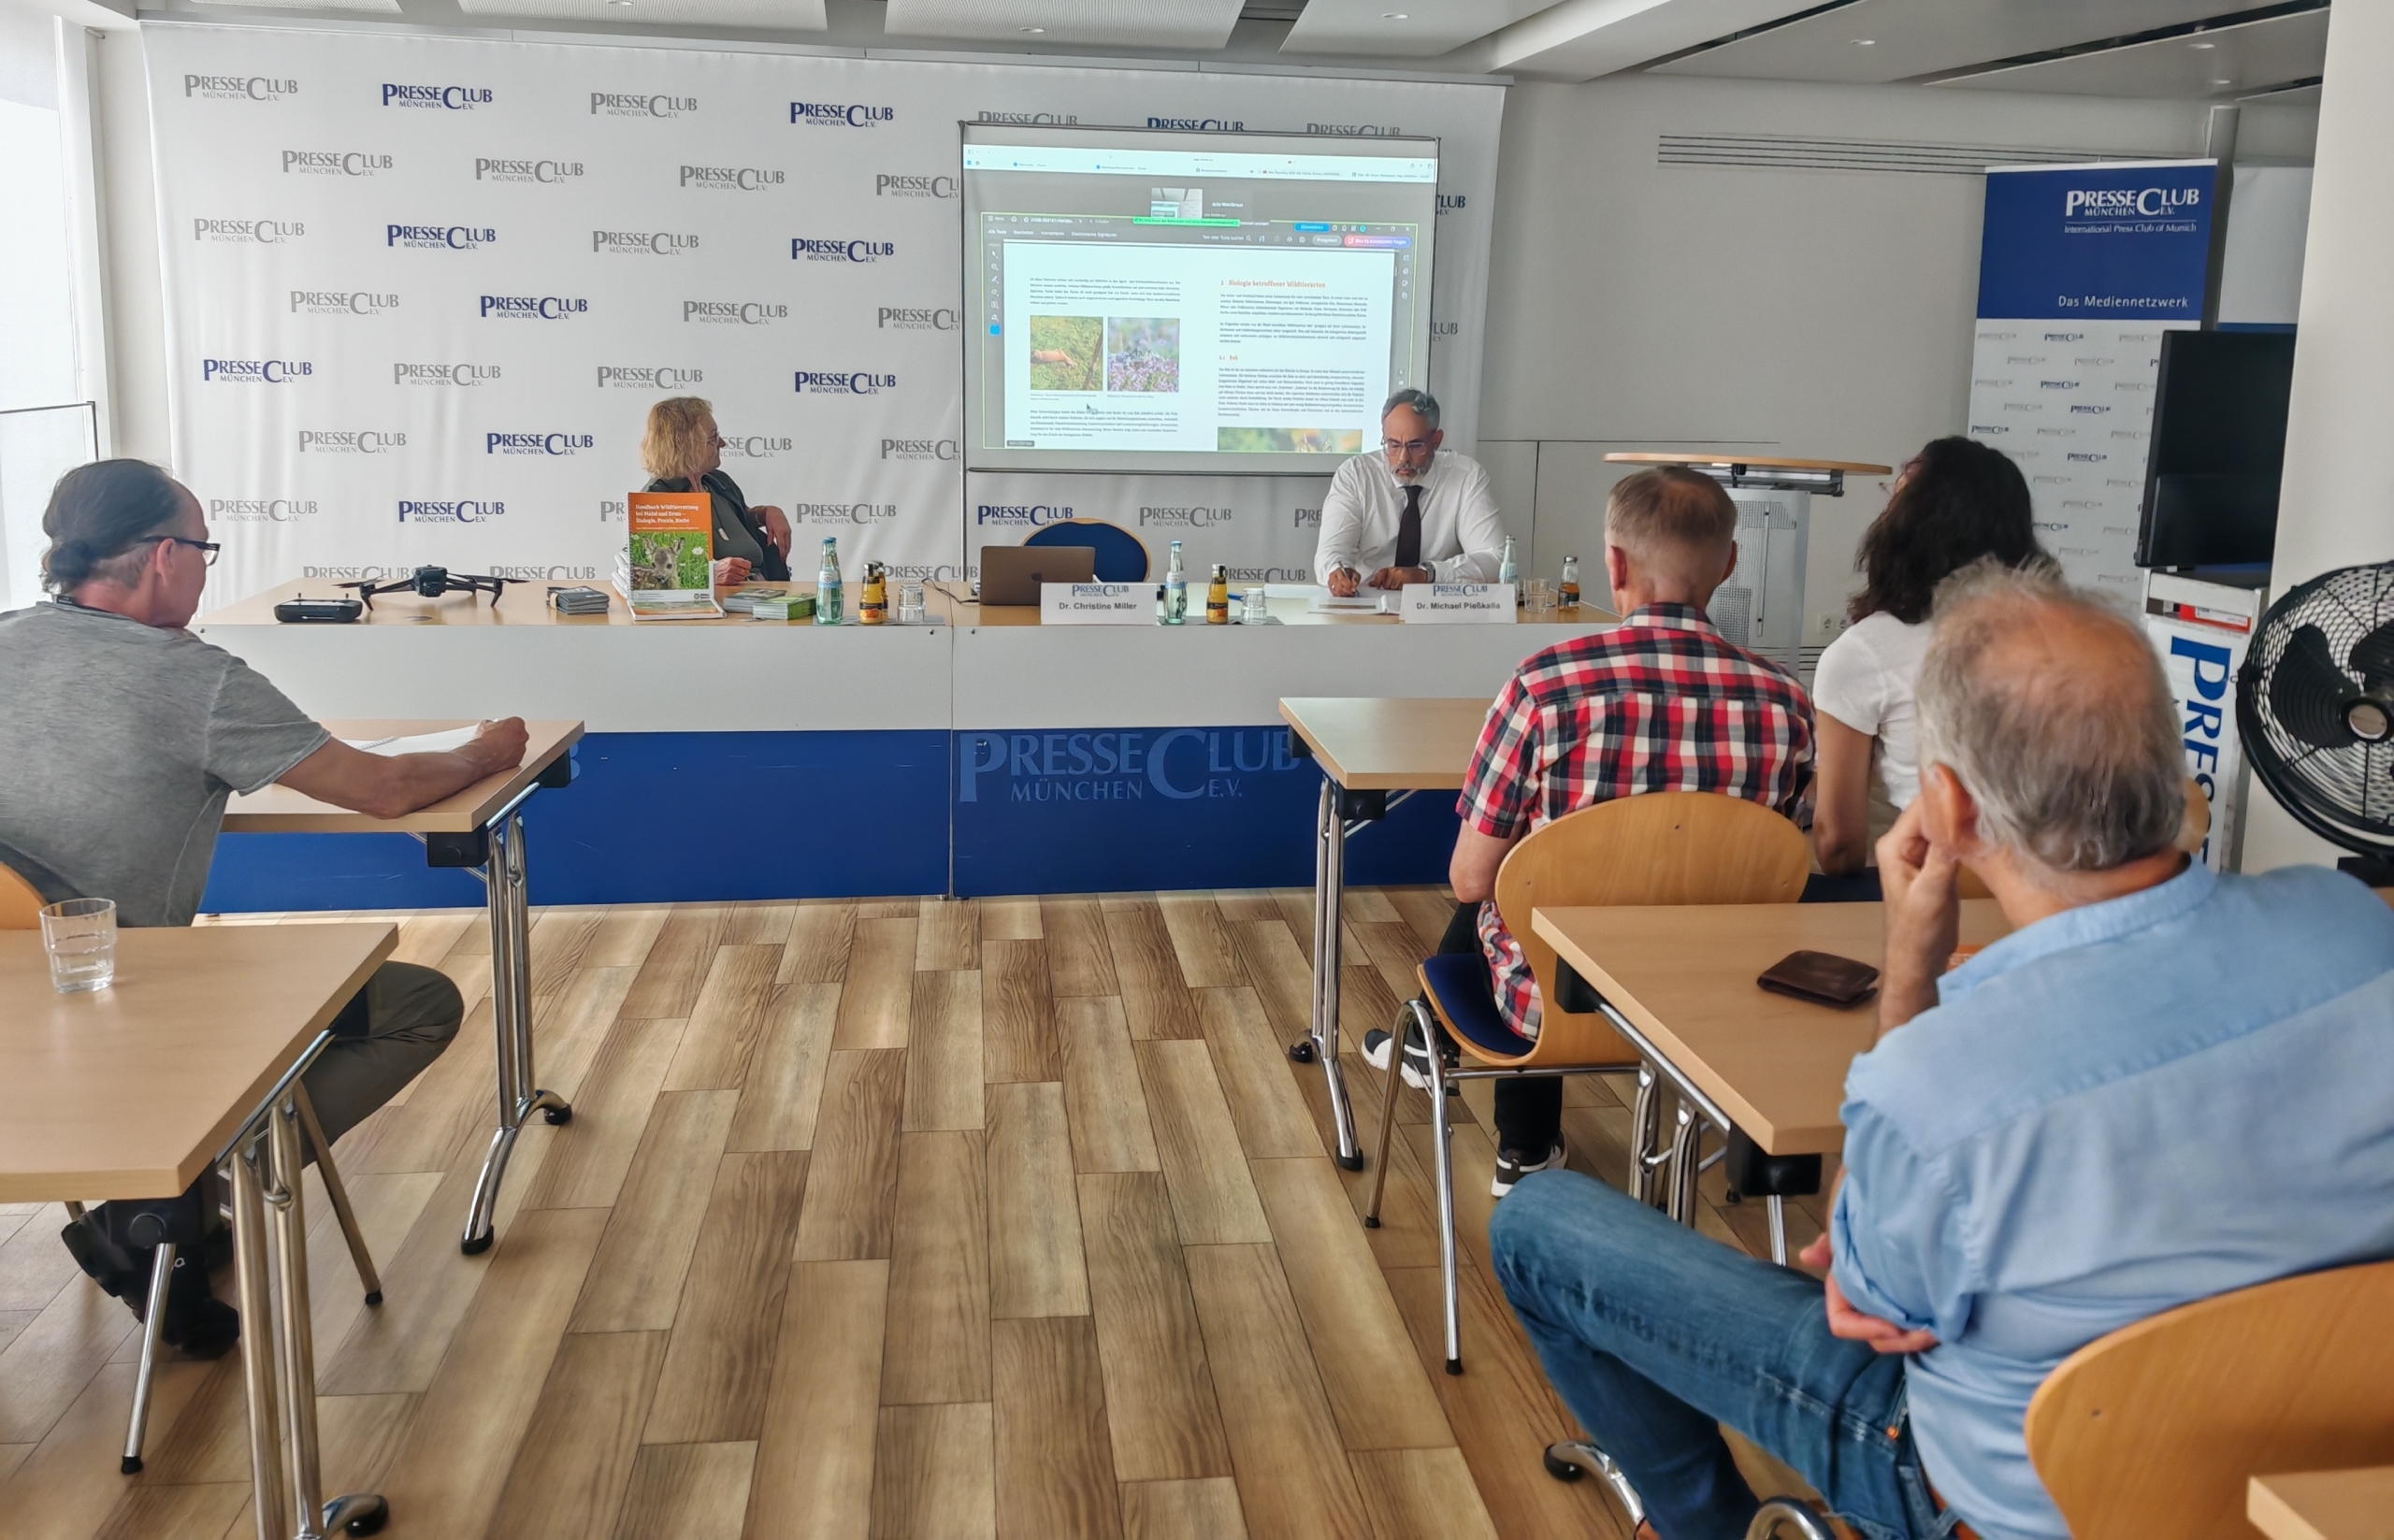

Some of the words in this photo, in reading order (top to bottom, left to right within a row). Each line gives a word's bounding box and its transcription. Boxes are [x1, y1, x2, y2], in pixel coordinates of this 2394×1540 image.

[184, 74, 298, 101] PRESSECLUB
[382, 83, 493, 109] PRESSECLUB
[591, 93, 698, 118] PRESSECLUB
[790, 102, 894, 127] PRESSECLUB
[282, 151, 393, 176] PRESSECLUB
[475, 158, 584, 183] PRESSECLUB
[680, 166, 786, 191] PRESSECLUB
[877, 175, 959, 198] PRESSECL
[2066, 188, 2199, 217] PRESSECLUB
[194, 218, 305, 243] PRESSECLUB
[387, 224, 496, 250] PRESSECLUB
[2065, 224, 2112, 233] International
[2135, 223, 2154, 232] Club
[2156, 223, 2164, 232] of
[2166, 223, 2196, 232] Munich
[593, 230, 699, 255] PRESSECLUB
[791, 238, 894, 263] PRESSECLUB
[290, 291, 399, 315] PRESSECLUB
[480, 295, 588, 320] PRESSECLUB
[683, 301, 788, 324] PRESSECLUB
[2058, 295, 2079, 307] Das
[2084, 295, 2188, 308] Mediennetzwerk
[879, 308, 959, 330] PRESSECL
[203, 359, 312, 383] PRESSECLUB
[394, 363, 501, 386] PRESSECLUB
[598, 367, 703, 389] PRESSECLUB
[795, 371, 897, 395] PRESSECLUB
[298, 430, 407, 453] PRESSECLUB
[486, 433, 594, 455] PRESSECLUB
[882, 439, 959, 460] PRESSECL
[210, 499, 318, 522] PRESSECLUB
[398, 501, 505, 523] PRESSECLUB
[797, 503, 897, 525] PRESSECLUB
[978, 506, 1073, 525] PRESSECLUB
[1139, 507, 1232, 527] PRESSECLUB
[1224, 569, 1305, 583] RESSECLUB
[959, 727, 1301, 802] PRESSECLUB
[1012, 778, 1143, 802] MÜNCHEN
[1208, 778, 1242, 797] E.V.
